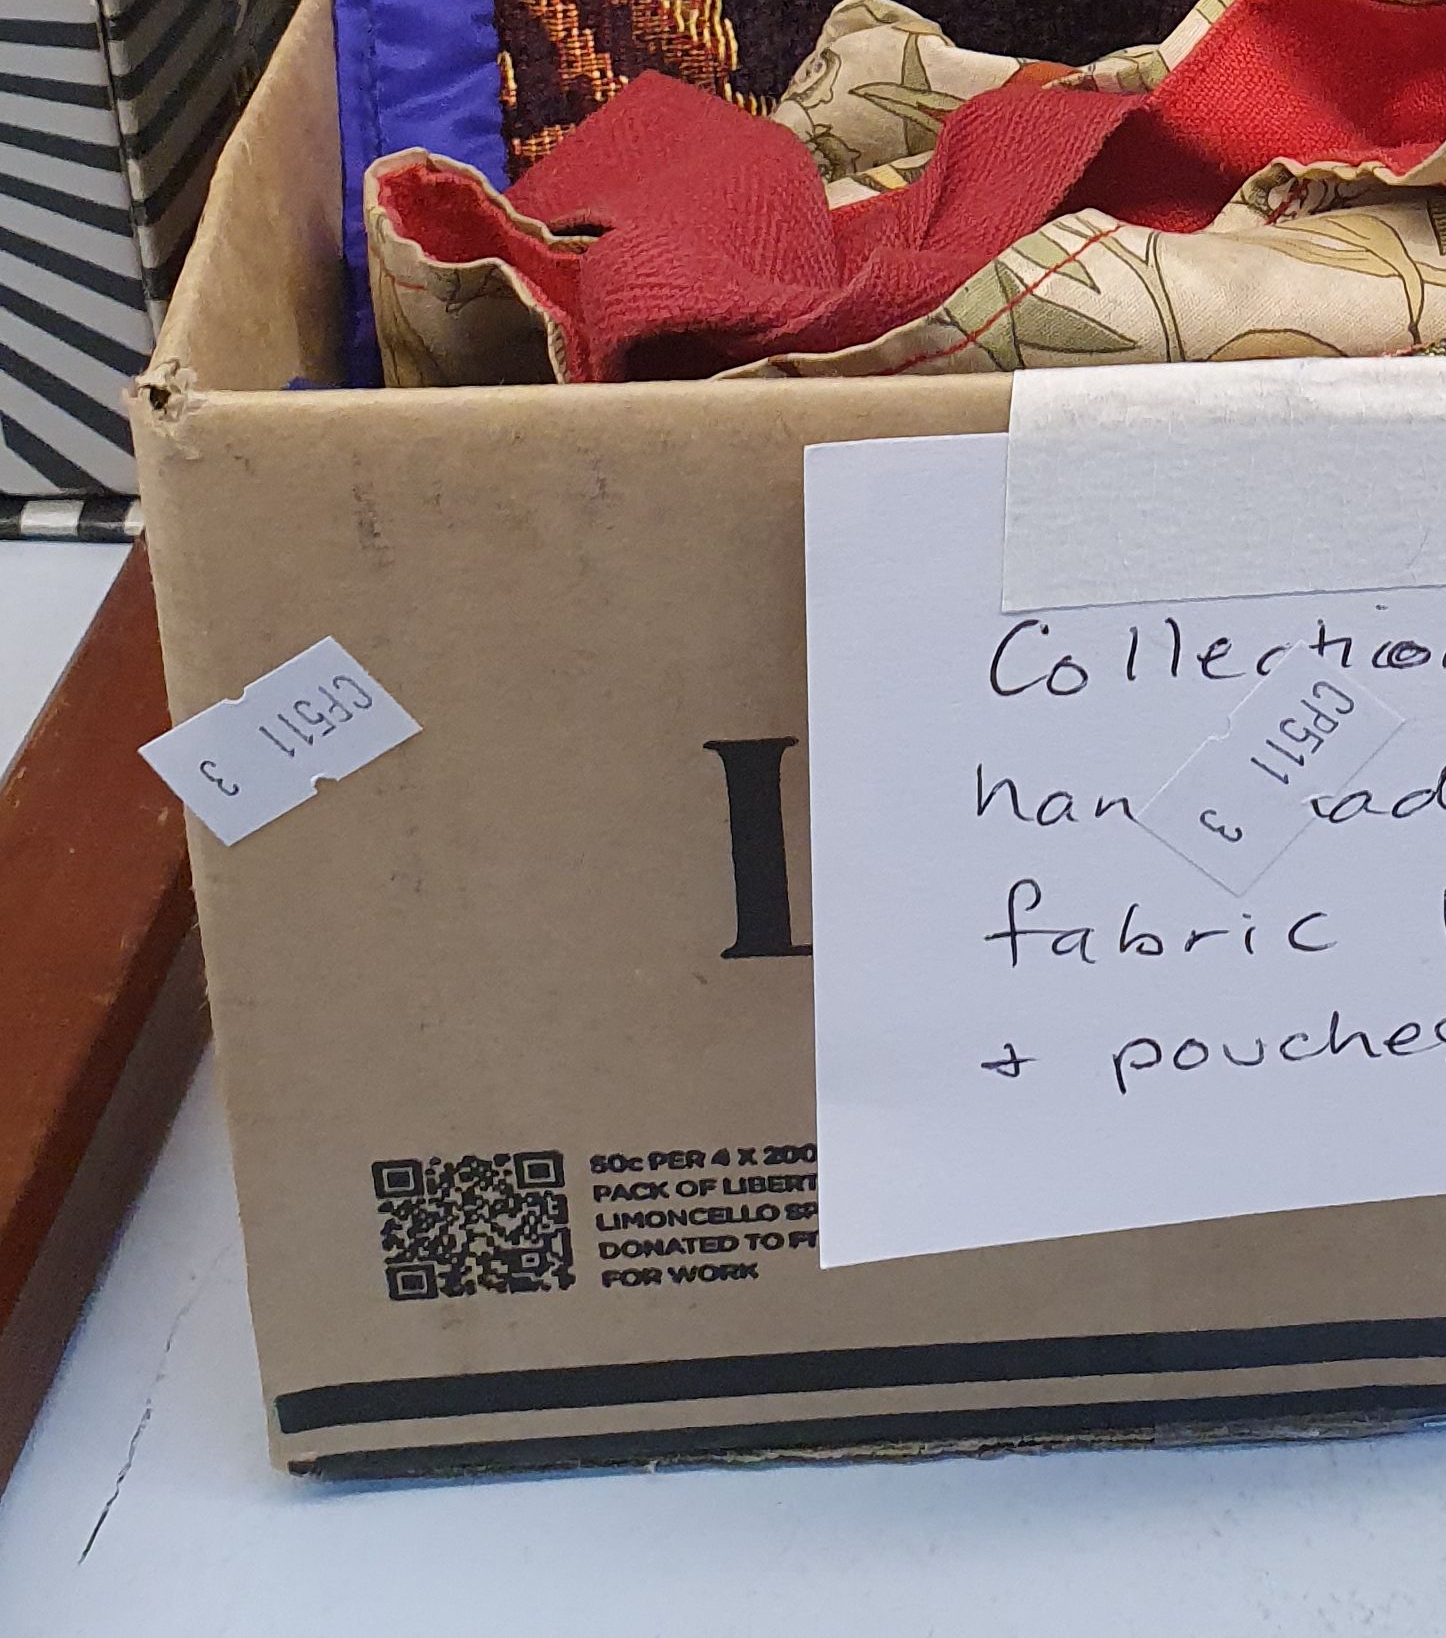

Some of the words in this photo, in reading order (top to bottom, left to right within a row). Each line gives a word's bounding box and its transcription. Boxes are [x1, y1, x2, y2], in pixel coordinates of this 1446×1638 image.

[1250, 680, 1355, 785] CP511
[199, 759, 240, 797] 3
[1199, 808, 1243, 843] 3
[984, 878, 1338, 968] fabric
[589, 1152, 644, 1174] 50c
[647, 1149, 707, 1171] PER
[592, 1180, 670, 1203] PACK
[675, 1178, 718, 1198] OF
[595, 1203, 781, 1232] LIMONCELLO
[597, 1234, 740, 1260] DONATED
[743, 1231, 786, 1252] TO
[601, 1266, 663, 1289] FOR
[667, 1262, 760, 1285] WORK
